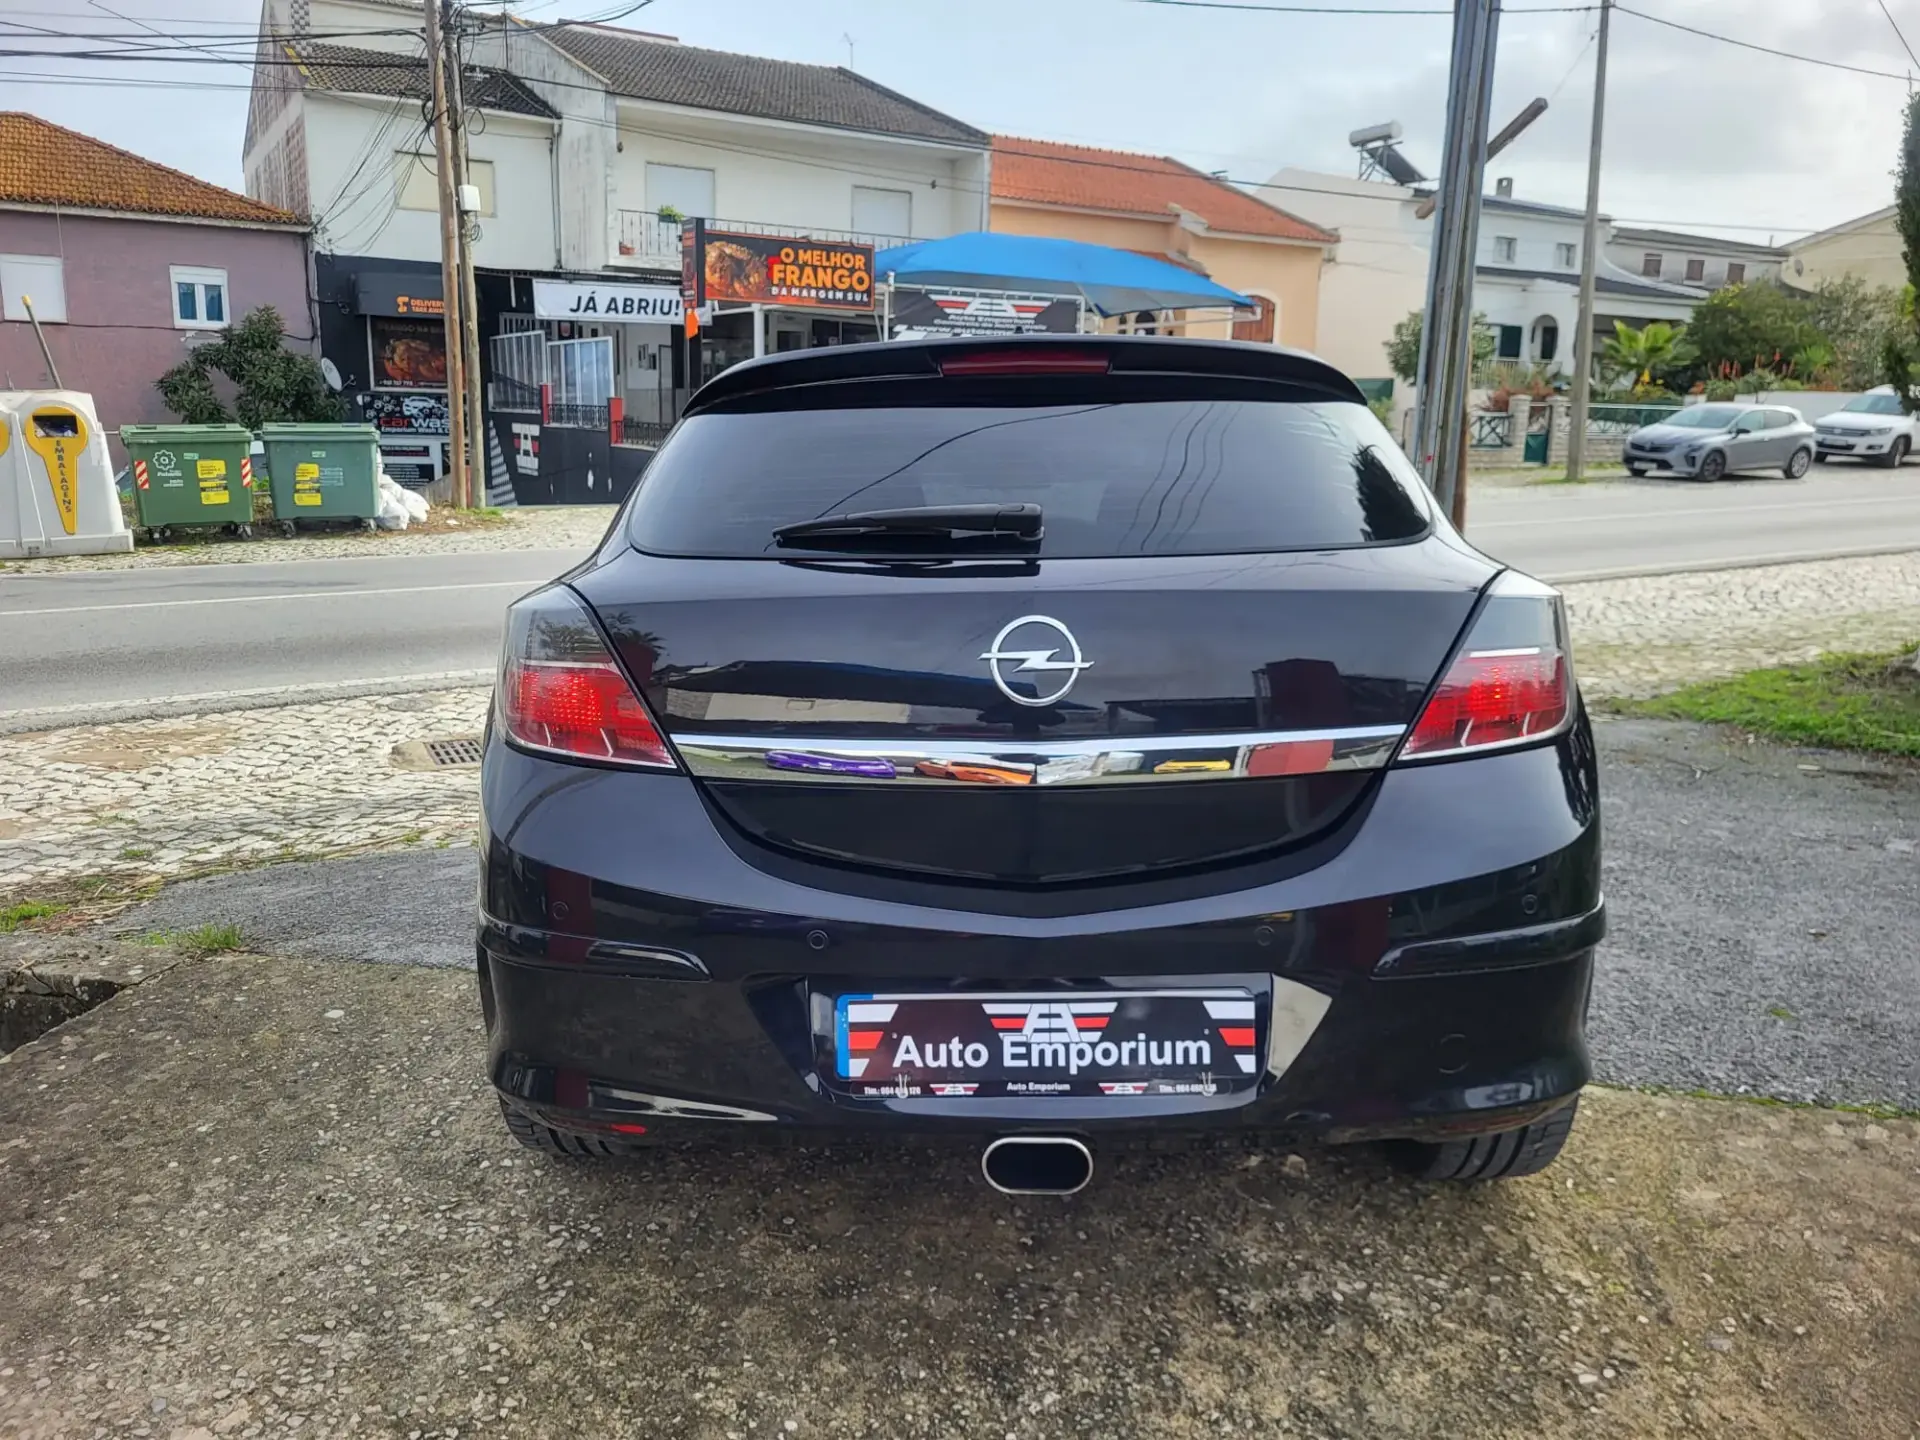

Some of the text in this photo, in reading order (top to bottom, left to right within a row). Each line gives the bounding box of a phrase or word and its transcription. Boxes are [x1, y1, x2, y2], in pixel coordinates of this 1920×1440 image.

[780, 247, 865, 271] O MELHOR
[772, 264, 870, 292] FRANGO
[569, 290, 680, 317] JÁ ABRIU!
[771, 286, 869, 302] DA MARGEM SUL
[55, 440, 72, 512] EMBALAGENS
[892, 1033, 1211, 1075] Auto Emporium
[1006, 1082, 1071, 1092] Auto Emporium
